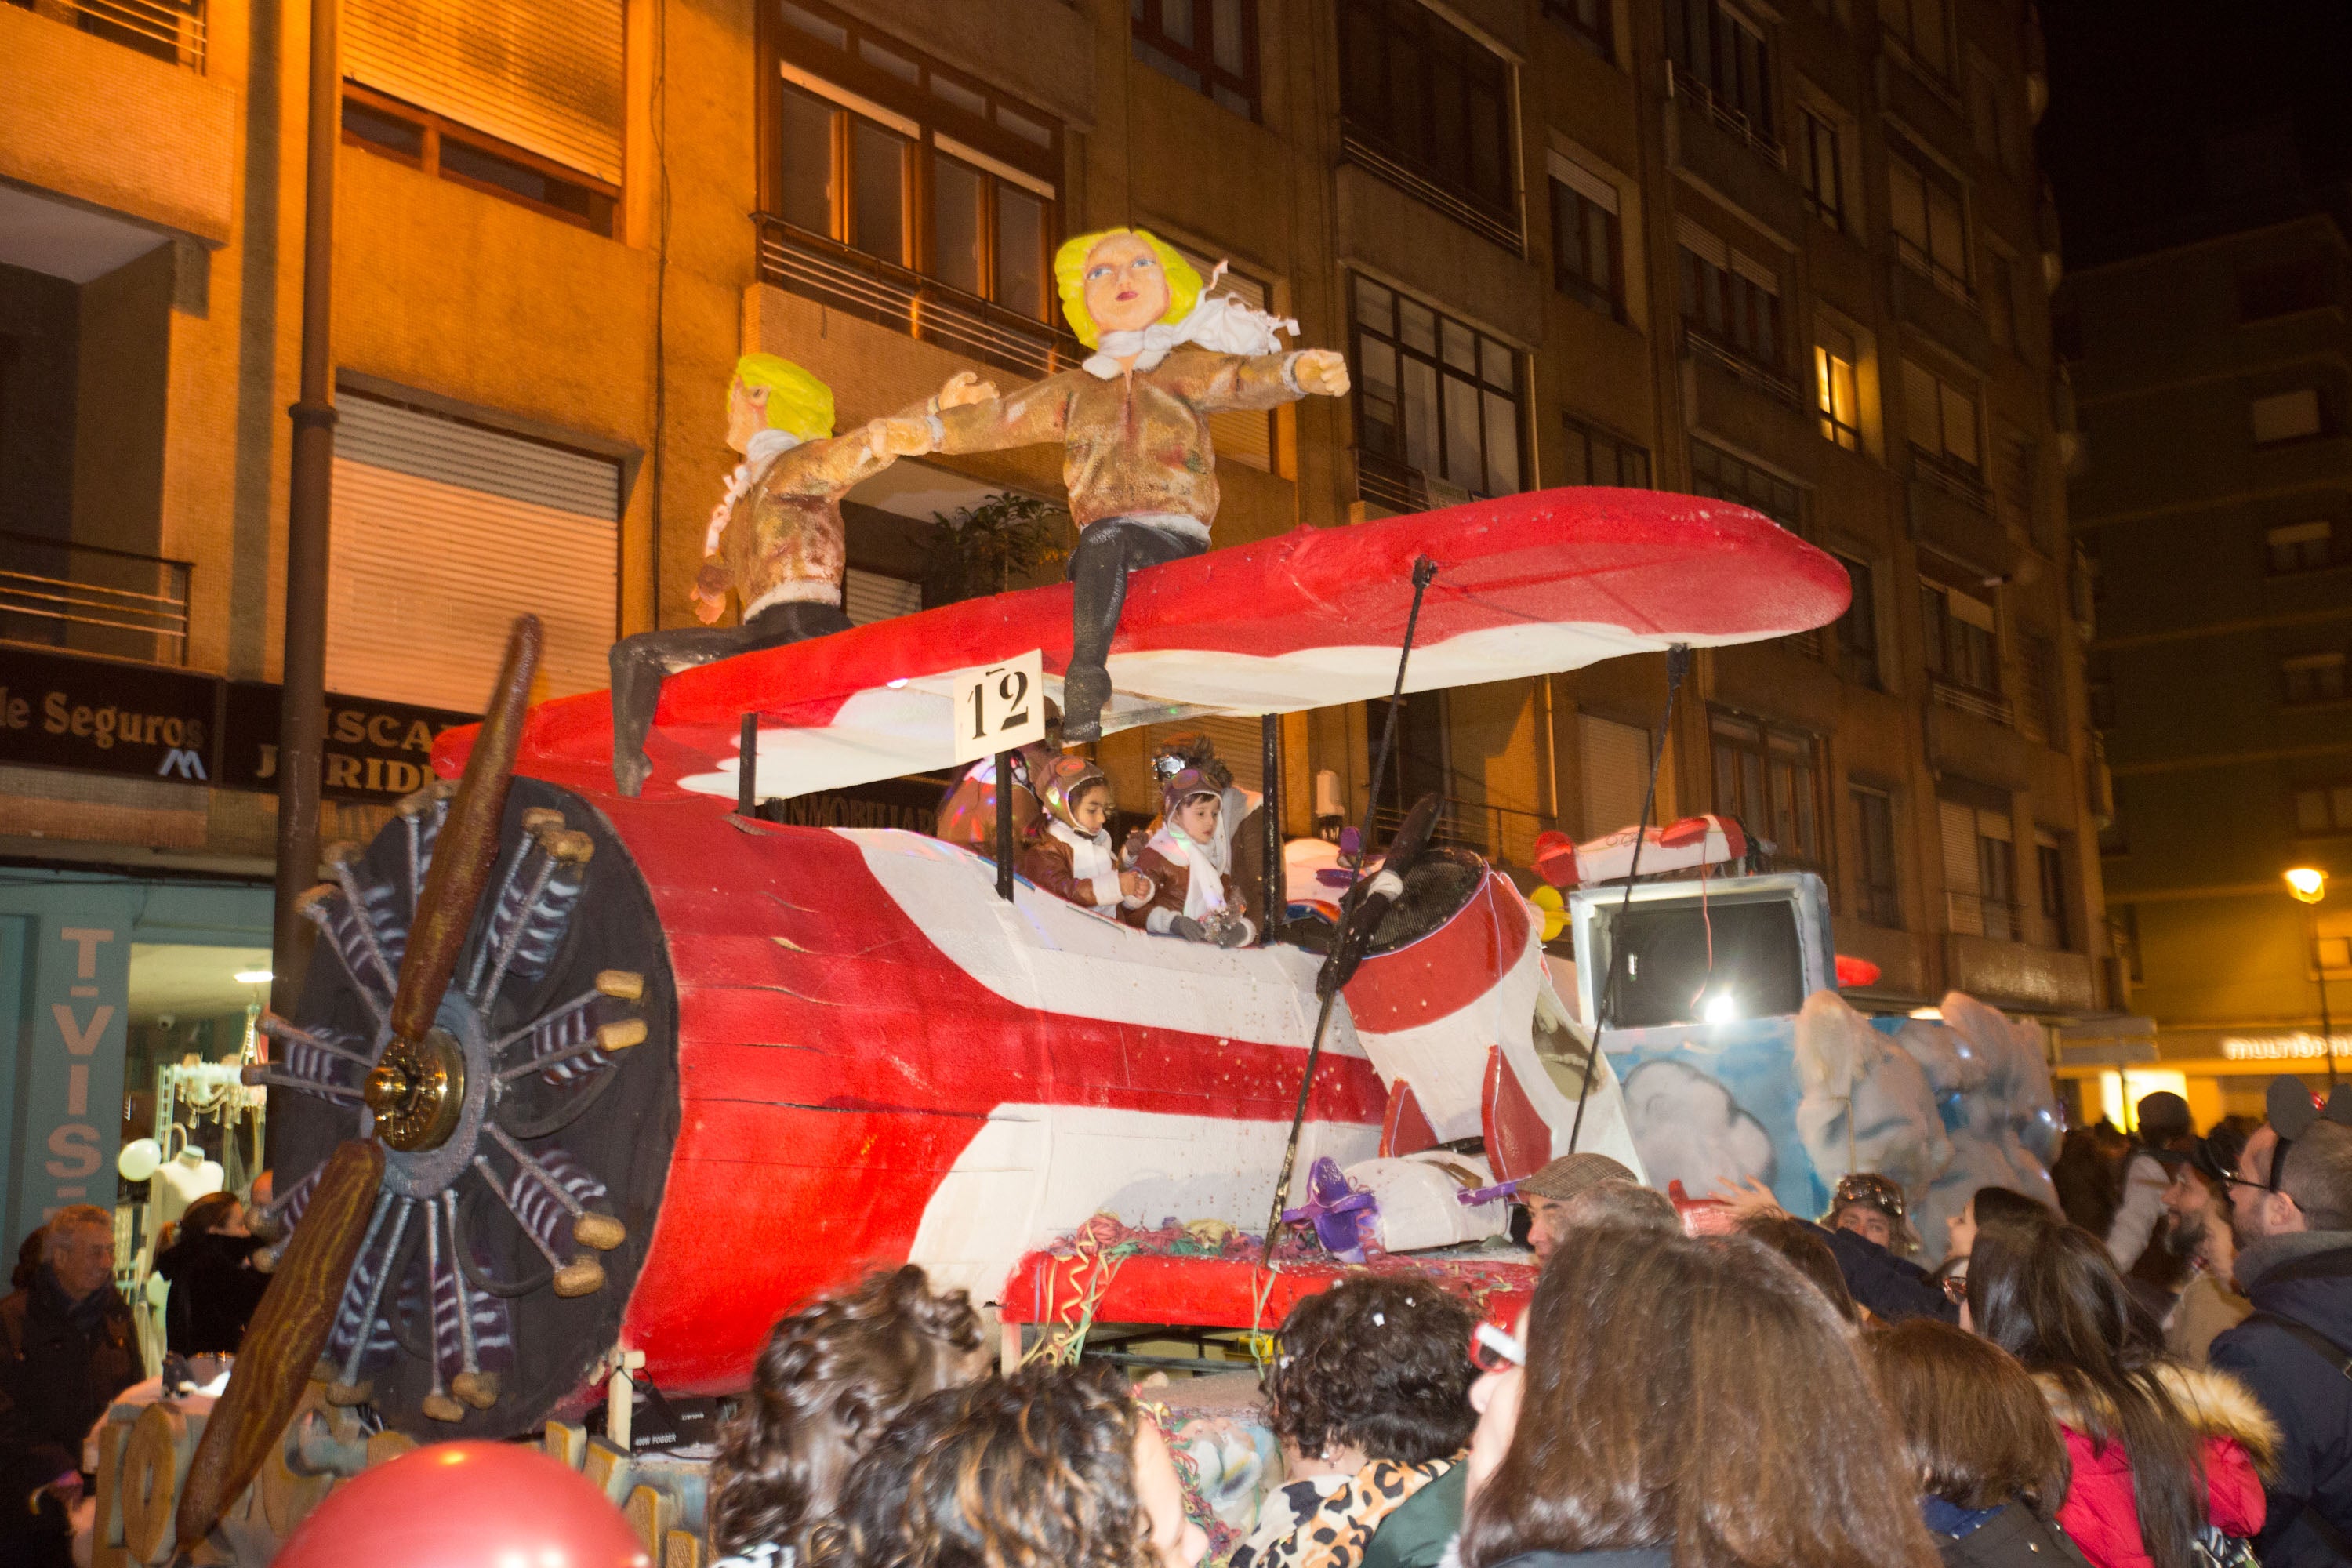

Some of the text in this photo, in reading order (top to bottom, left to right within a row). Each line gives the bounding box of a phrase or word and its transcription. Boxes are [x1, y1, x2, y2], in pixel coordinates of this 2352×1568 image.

[43, 691, 205, 750] Seguros
[967, 668, 1029, 739] 12
[652, 1433, 677, 1445] FOGGER
